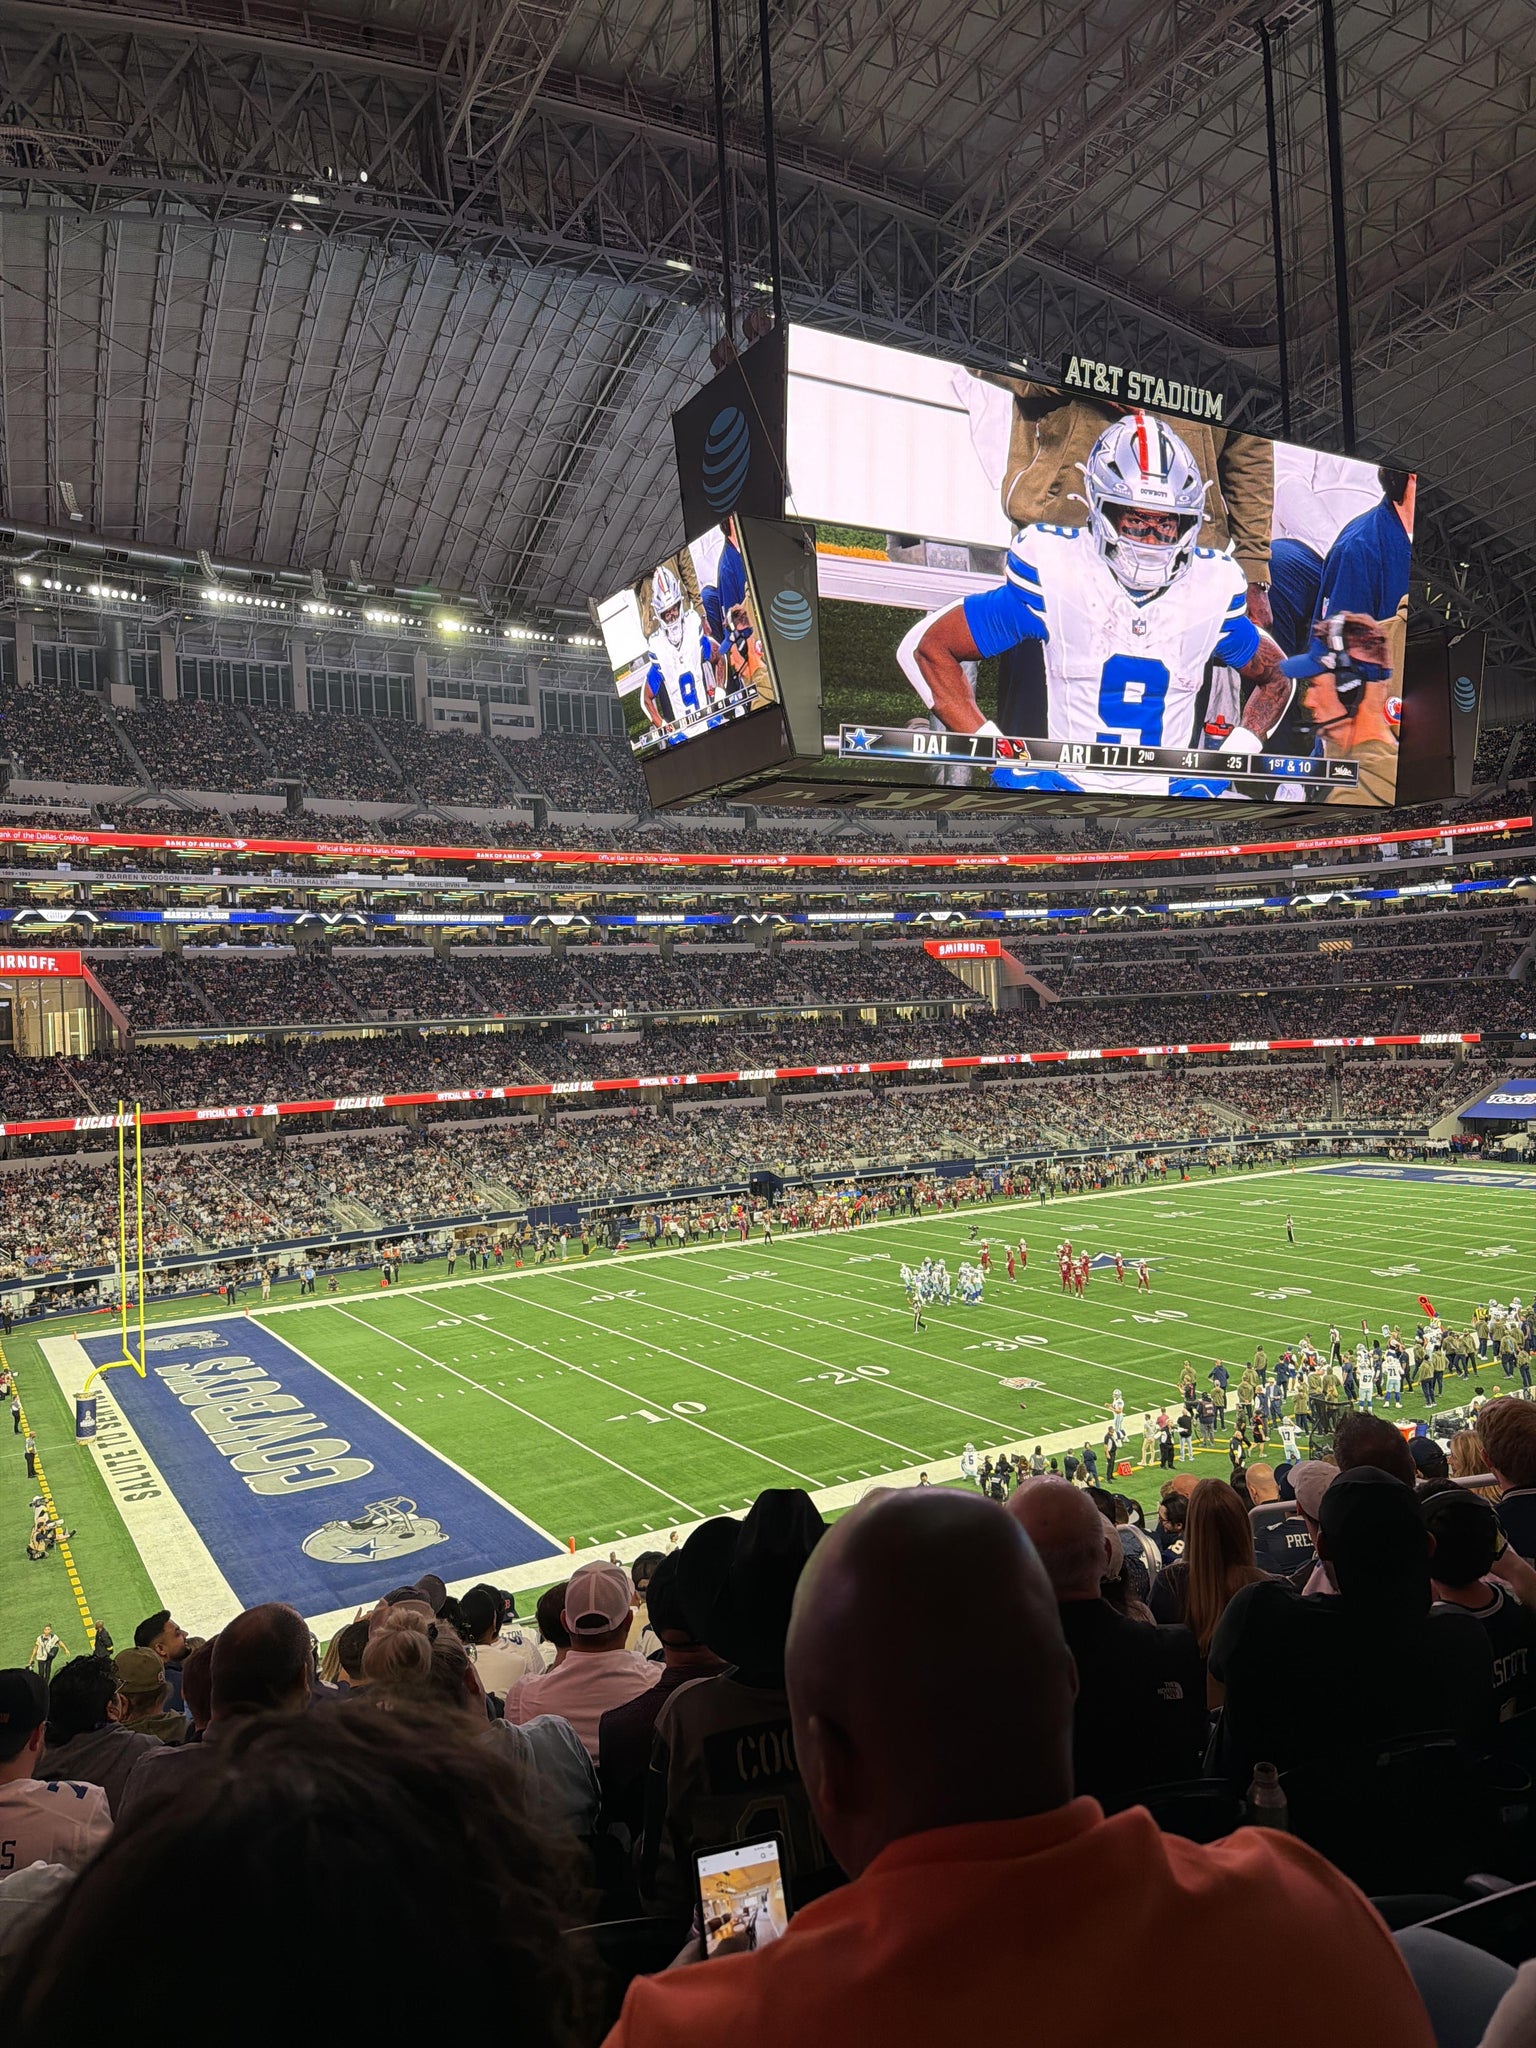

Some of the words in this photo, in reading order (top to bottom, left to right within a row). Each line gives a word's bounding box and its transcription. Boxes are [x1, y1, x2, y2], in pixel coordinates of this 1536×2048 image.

[1064, 356, 1124, 396] AT&T
[1127, 370, 1224, 422] STADIUM
[1096, 654, 1170, 746] 9
[913, 734, 950, 756] DAL
[968, 738, 978, 758] 7
[1059, 744, 1091, 764] ARI
[1102, 746, 1120, 766] 17
[1138, 750, 1154, 764] 2ND
[1182, 754, 1199, 768] :41
[1226, 757, 1242, 769] :25
[1268, 758, 1286, 771] 1ST
[1287, 761, 1296, 772] &
[1299, 761, 1312, 773] 10
[23, 832, 35, 840] the
[37, 832, 58, 841] Dallas
[59, 834, 90, 843] Cowboys
[1420, 1034, 1448, 1044] LUCAS
[1449, 1034, 1462, 1043] OIL
[1230, 1042, 1256, 1051] LUCAS
[1257, 1041, 1270, 1050] OIL
[1067, 1050, 1089, 1060] LUCAS
[1090, 1050, 1102, 1058] OIL
[907, 1060, 930, 1070] LUCAS
[931, 1059, 943, 1068] OIL
[738, 1070, 764, 1080] LUCAS
[764, 1069, 778, 1079] OIL
[552, 1082, 579, 1094] LUCAS
[580, 1081, 594, 1092] OIL
[437, 1092, 461, 1100] OFFICIAL
[334, 1097, 367, 1110] LUCAS
[369, 1096, 385, 1108] OIL
[197, 1109, 226, 1119] OFFICIAL
[227, 1108, 238, 1117] OIL
[74, 1115, 114, 1130] LUCAS
[116, 1114, 136, 1127] OIL
[1370, 1264, 1421, 1277] 40
[1252, 1286, 1312, 1300] 50
[1132, 1309, 1189, 1324] 40
[982, 1334, 1049, 1352] 30
[818, 1365, 890, 1386] 20
[1388, 1368, 1397, 1376] 71
[629, 1400, 708, 1424] 10
[154, 1356, 374, 1496] COWBOYS
[96, 1432, 132, 1450] TO
[1282, 1431, 1291, 1441] 17
[968, 1454, 974, 1465] 5
[102, 1448, 162, 1502] SALUTE
[1122, 1463, 1131, 1474] 20
[504, 1599, 511, 1609] B
